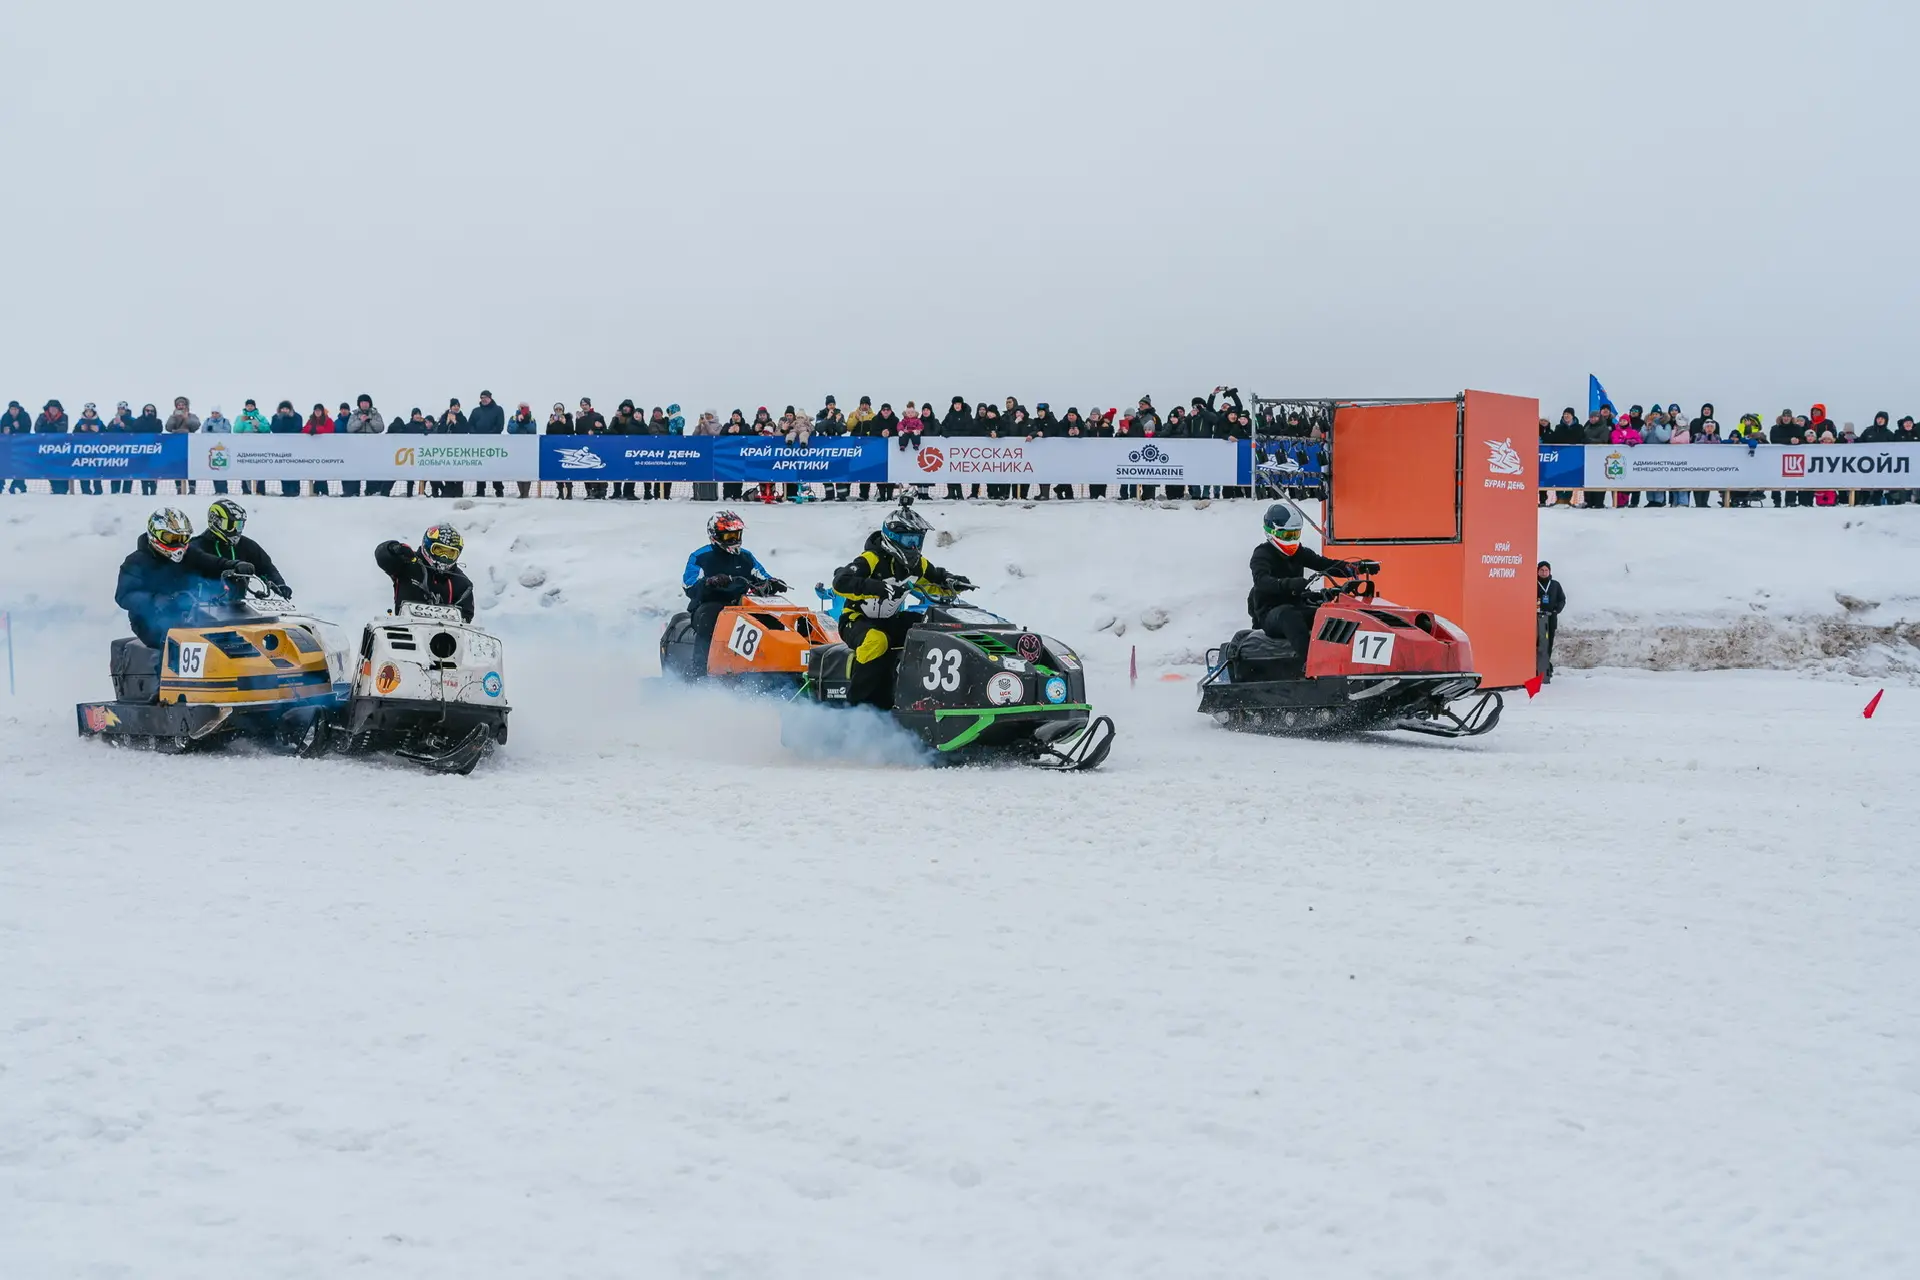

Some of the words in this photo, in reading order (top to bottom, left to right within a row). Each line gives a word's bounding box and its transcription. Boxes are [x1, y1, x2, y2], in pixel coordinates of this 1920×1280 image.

[39, 443, 71, 454] КРАЙ
[73, 443, 162, 454] ПОКОРИТЕЛЕЙ
[418, 447, 508, 458] ЗАРУБЕЖНЕФТЬ
[740, 445, 772, 457] КРАЙ
[774, 446, 862, 457] ПОКОРИТЕЛЕЙ
[949, 447, 1023, 459] РУССКАЯ
[625, 450, 664, 458] БУРАН
[668, 450, 700, 459] ДЕНЬ
[71, 457, 129, 467] АРКТИКИ
[772, 460, 829, 470] АРКТИКИ
[949, 461, 1034, 473] МЕХАНИКА
[1808, 452, 1910, 474] ЛУКОЙЛ
[1116, 467, 1184, 476] SNOWMARINE
[1484, 479, 1506, 489] БУРАН
[1507, 480, 1525, 490] ДЕНЬ
[1494, 541, 1511, 552] КРАЙ
[1481, 554, 1523, 565] ПОКОРИТЕЛЕЙ
[1488, 567, 1516, 578] АРКТИКИ
[735, 623, 758, 656] 18
[1358, 635, 1388, 660] 17
[181, 646, 202, 674] 95
[922, 648, 963, 692] 33
